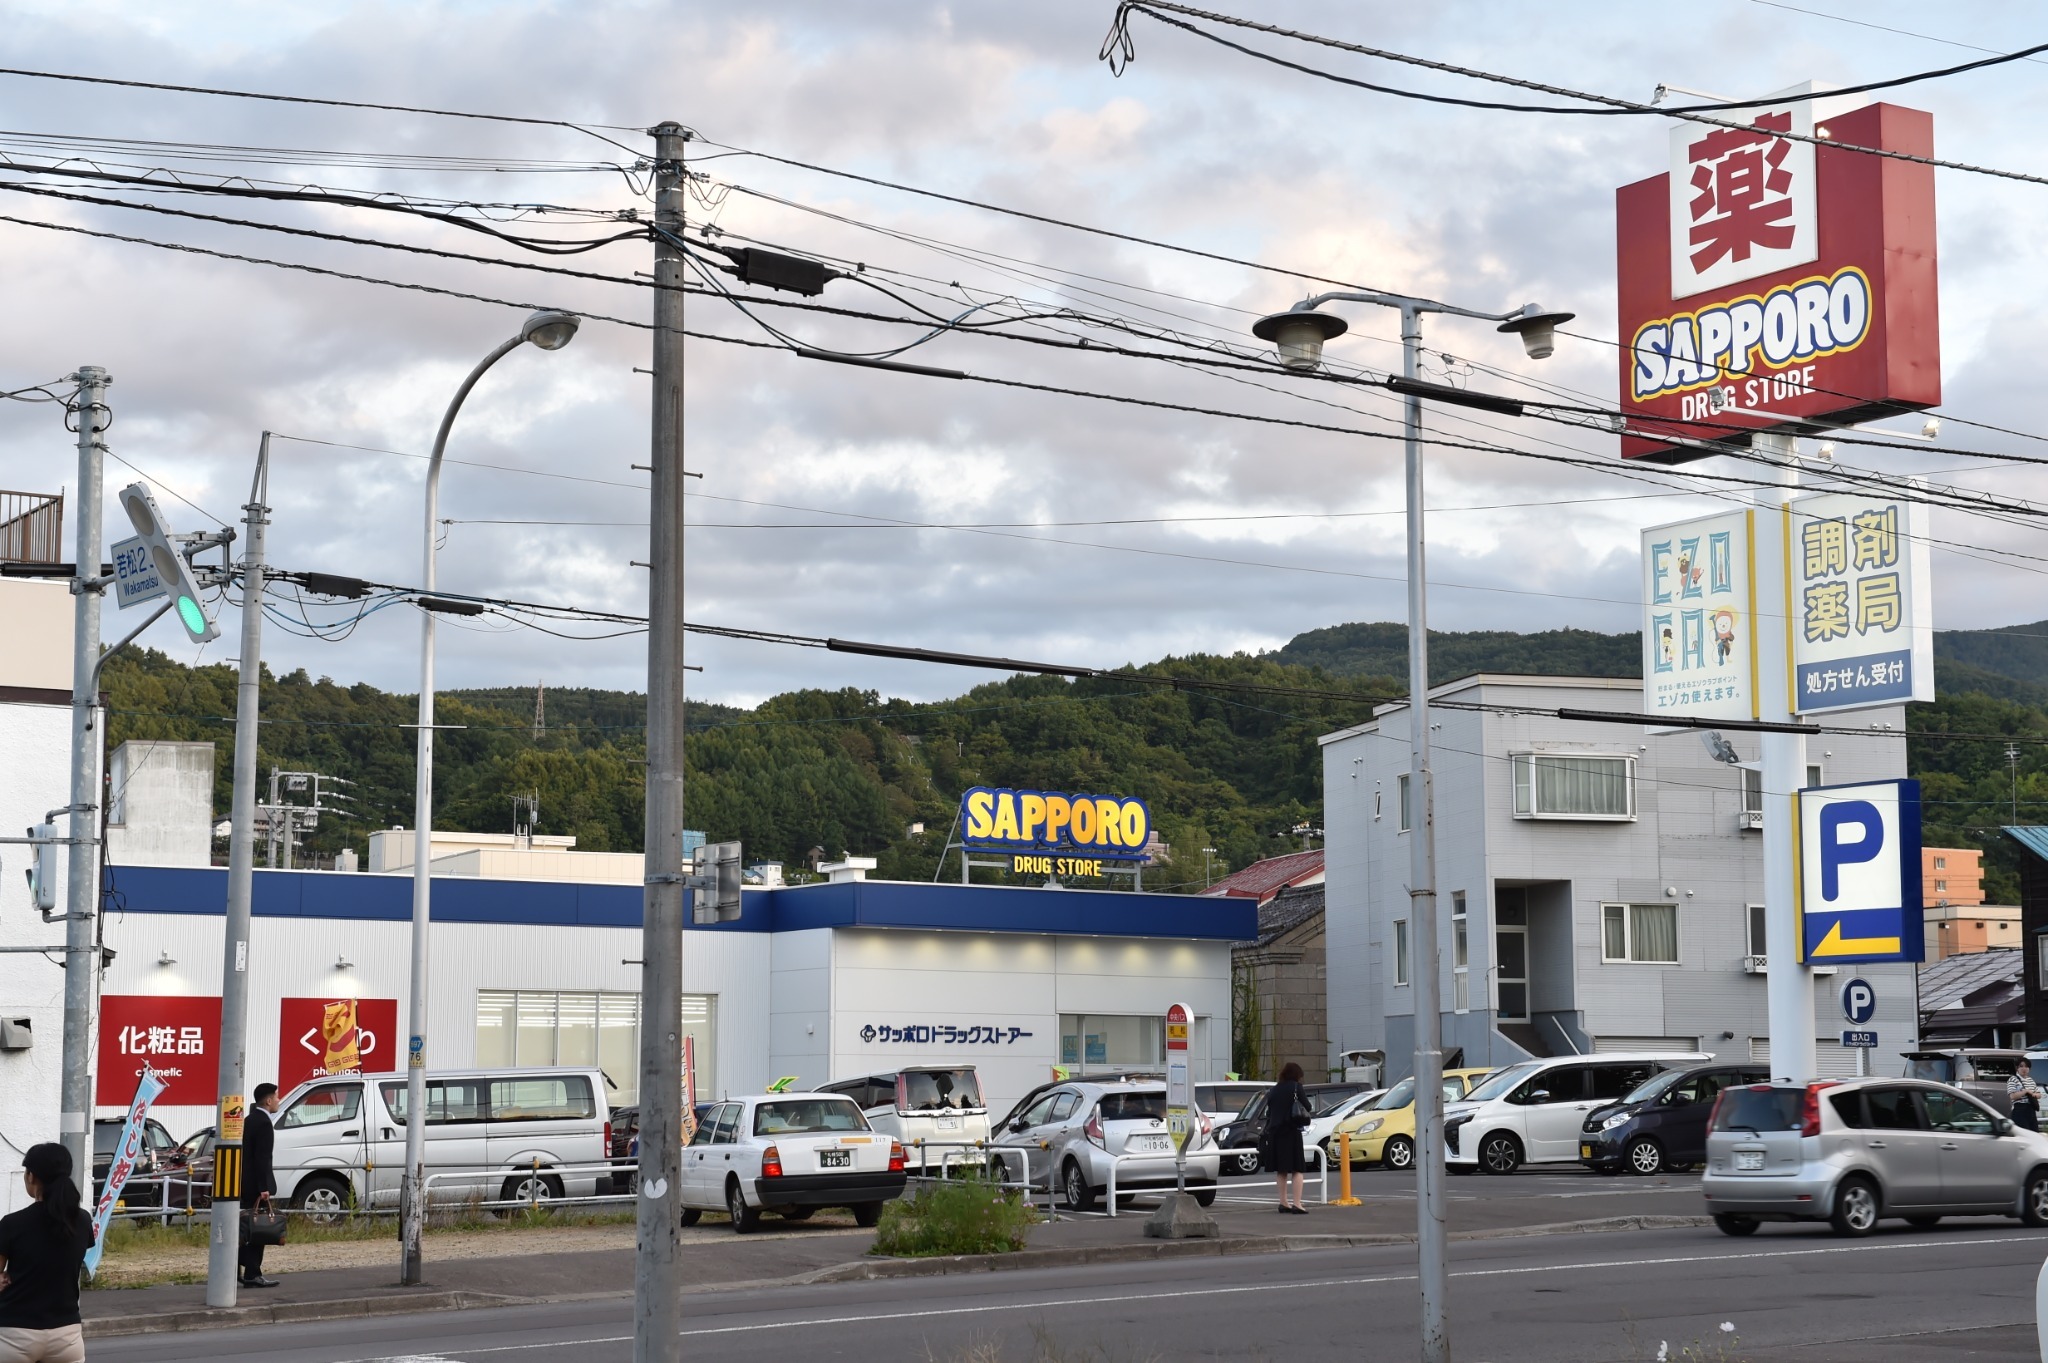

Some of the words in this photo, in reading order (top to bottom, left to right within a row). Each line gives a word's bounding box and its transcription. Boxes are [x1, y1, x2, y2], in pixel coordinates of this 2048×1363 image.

[1688, 111, 1796, 275] 薬
[1635, 273, 1867, 394] SAPPORO
[1745, 365, 1816, 408] STORE
[1802, 505, 1899, 580] 調剤
[1652, 531, 1732, 605] EZO
[123, 575, 159, 597] Wakamatsu
[1804, 572, 1902, 643] 薬局
[1807, 660, 1904, 695] 処方せん受付
[1658, 686, 1740, 707] エゾカ使えます。
[967, 790, 1147, 848] SAPPORO
[1014, 855, 1052, 874] DRUG
[1056, 858, 1102, 877] STORE
[1819, 800, 1885, 902] P
[1850, 985, 1871, 1019] P
[118, 1026, 204, 1054] 化粧品
[300, 1027, 376, 1055] くり
[878, 1025, 1033, 1044] サッポロドラッグストアー
[1851, 1033, 1870, 1041] 出入口
[135, 1067, 182, 1077] csmetic
